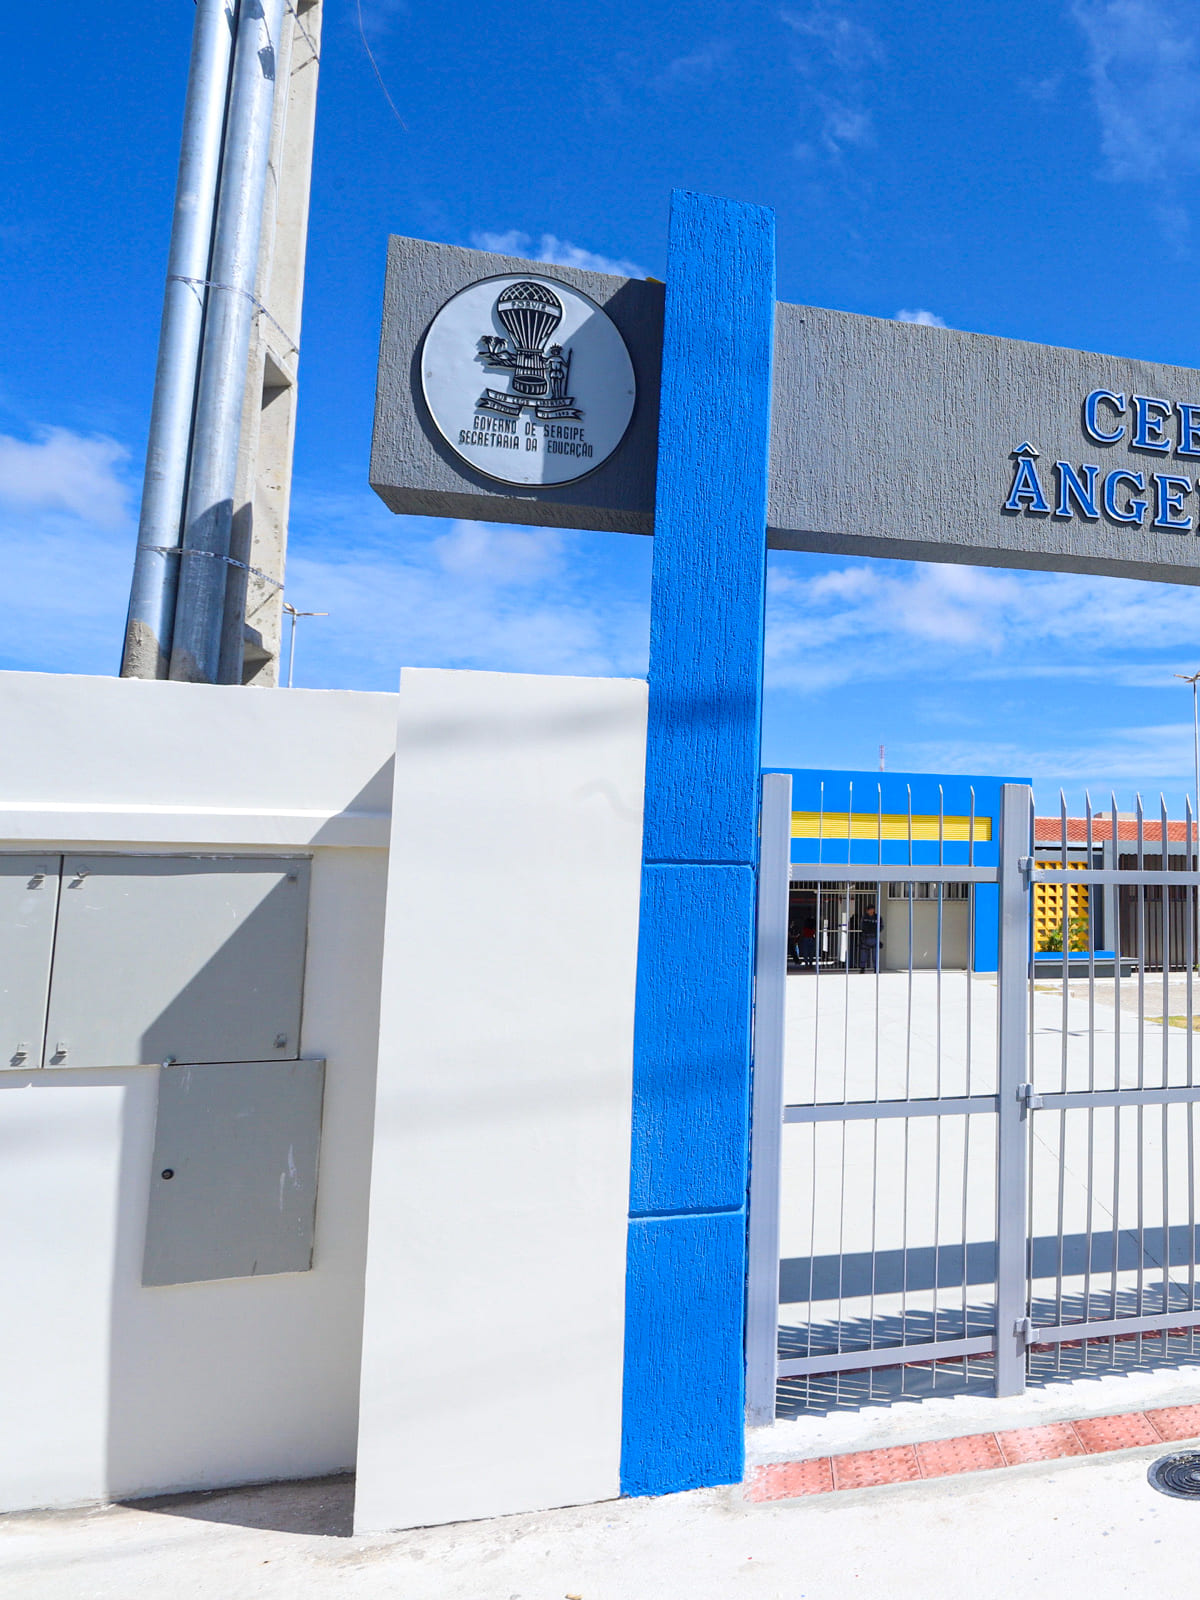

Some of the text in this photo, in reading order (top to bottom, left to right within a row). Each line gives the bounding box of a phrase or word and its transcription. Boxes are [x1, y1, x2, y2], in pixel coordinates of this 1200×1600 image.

[473, 415, 585, 442] GOVERNO DE SERGIPE
[459, 429, 593, 458] SECRETARIA DA EDUCAÇÃO
